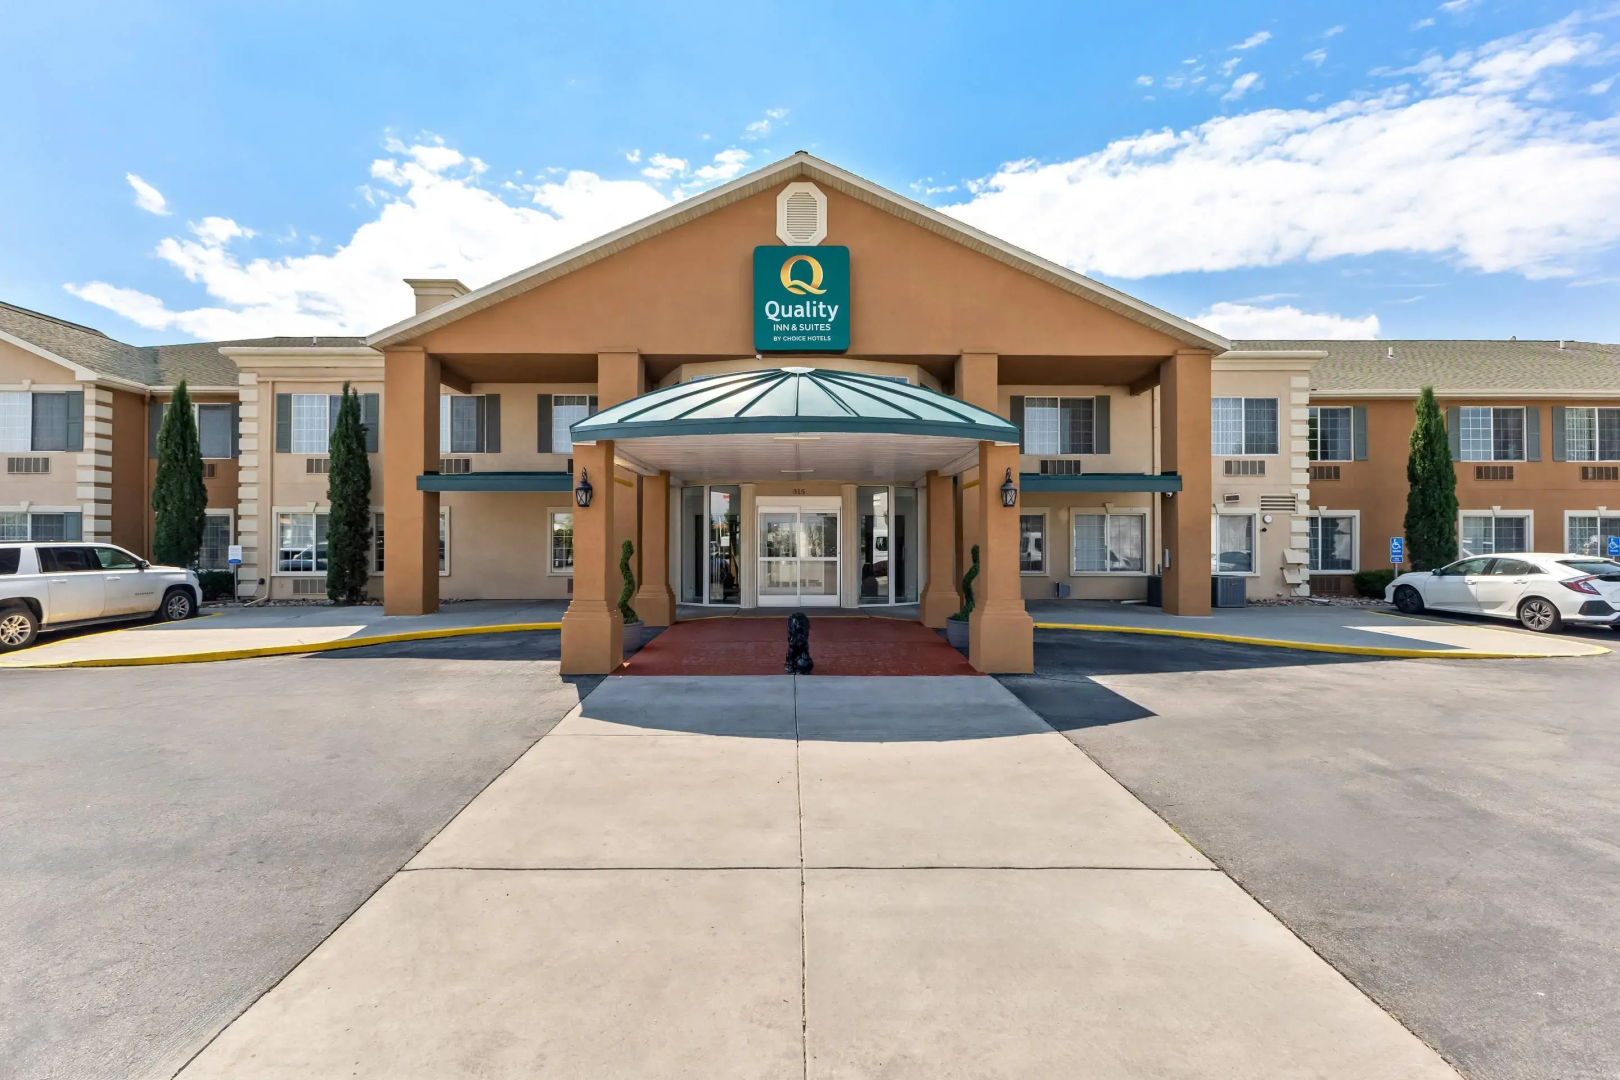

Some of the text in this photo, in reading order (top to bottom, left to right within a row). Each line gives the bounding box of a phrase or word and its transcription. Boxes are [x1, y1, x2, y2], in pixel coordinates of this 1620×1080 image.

[765, 300, 839, 322] Quality
[773, 323, 831, 331] INN & SUITES
